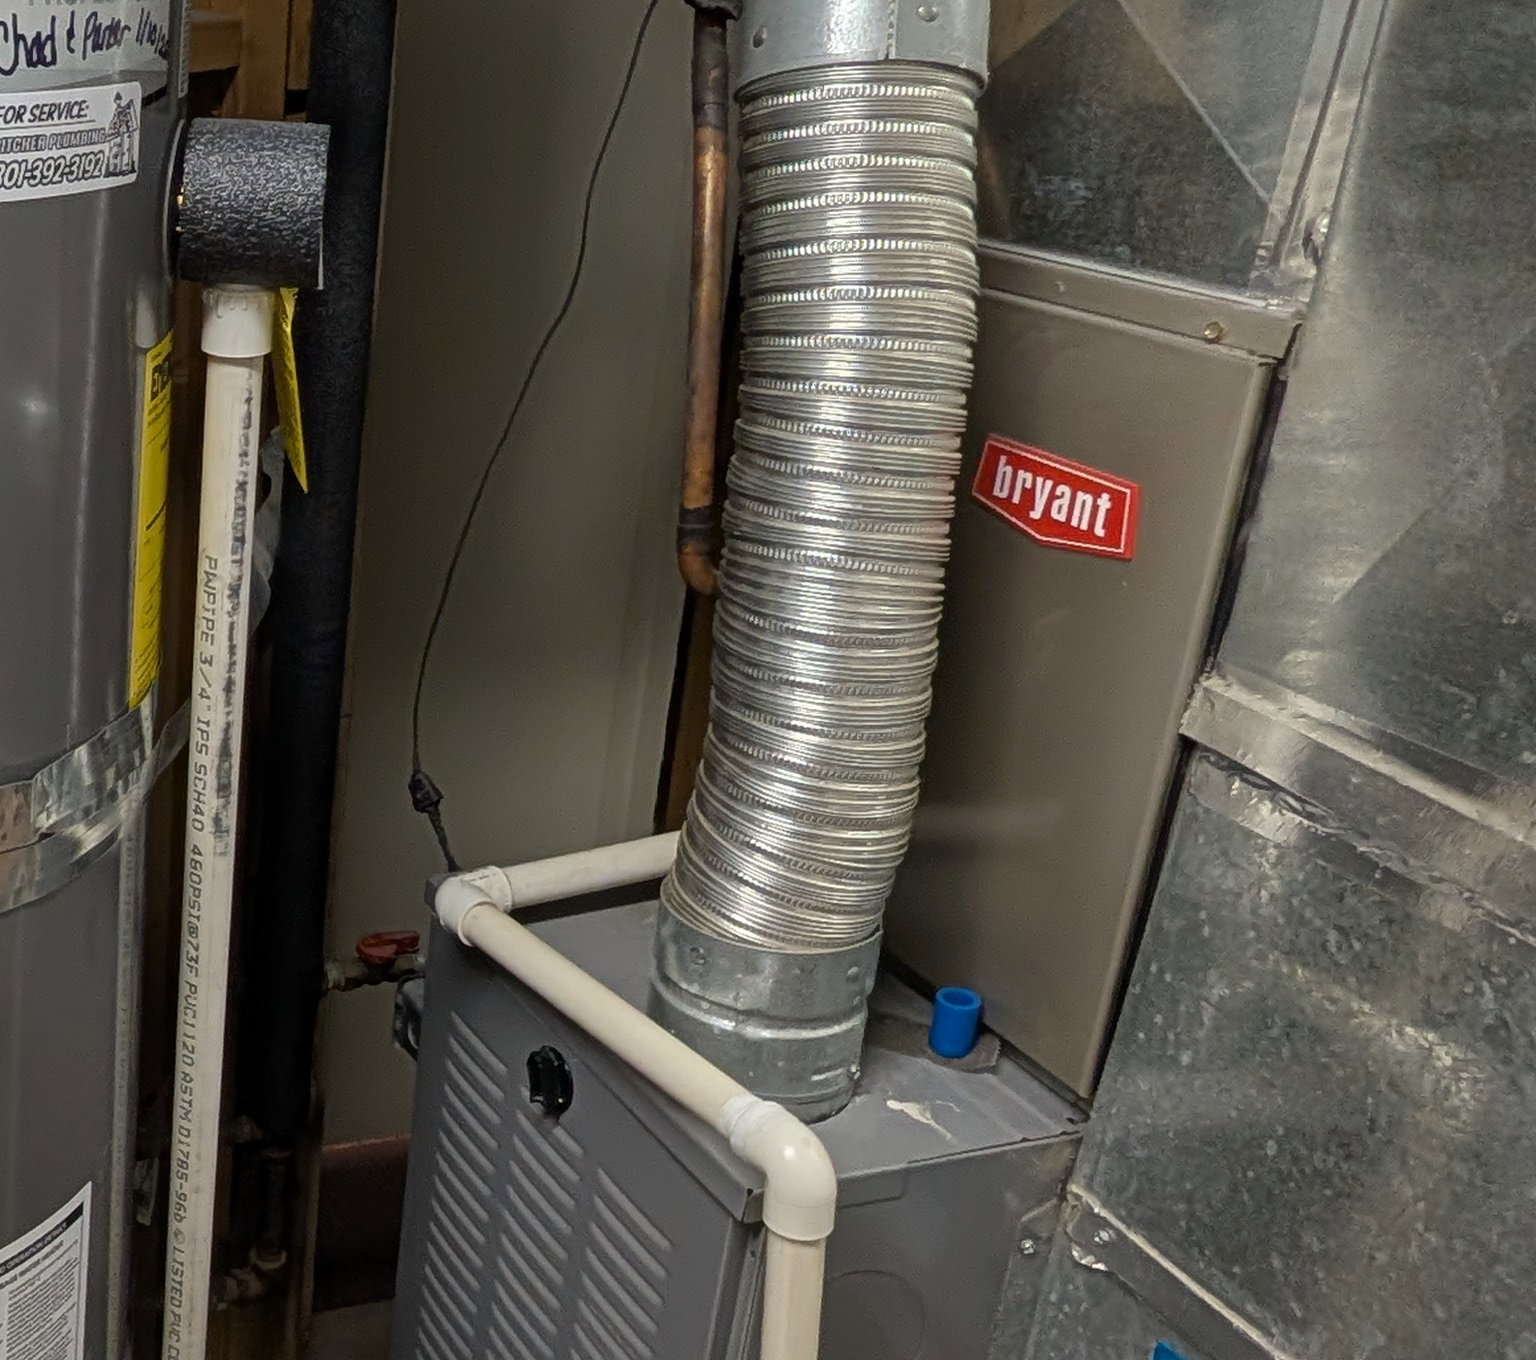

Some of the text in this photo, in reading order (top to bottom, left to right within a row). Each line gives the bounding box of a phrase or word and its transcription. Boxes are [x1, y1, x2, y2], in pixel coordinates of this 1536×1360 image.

[28, 99, 90, 124] SERVICE:
[47, 127, 107, 151] PLUMBING
[992, 455, 1112, 538] bryant
[200, 554, 218, 647] PWPIPE
[194, 715, 210, 757] IPS
[191, 761, 208, 832] SCH40
[178, 1070, 193, 1122] ASTM
